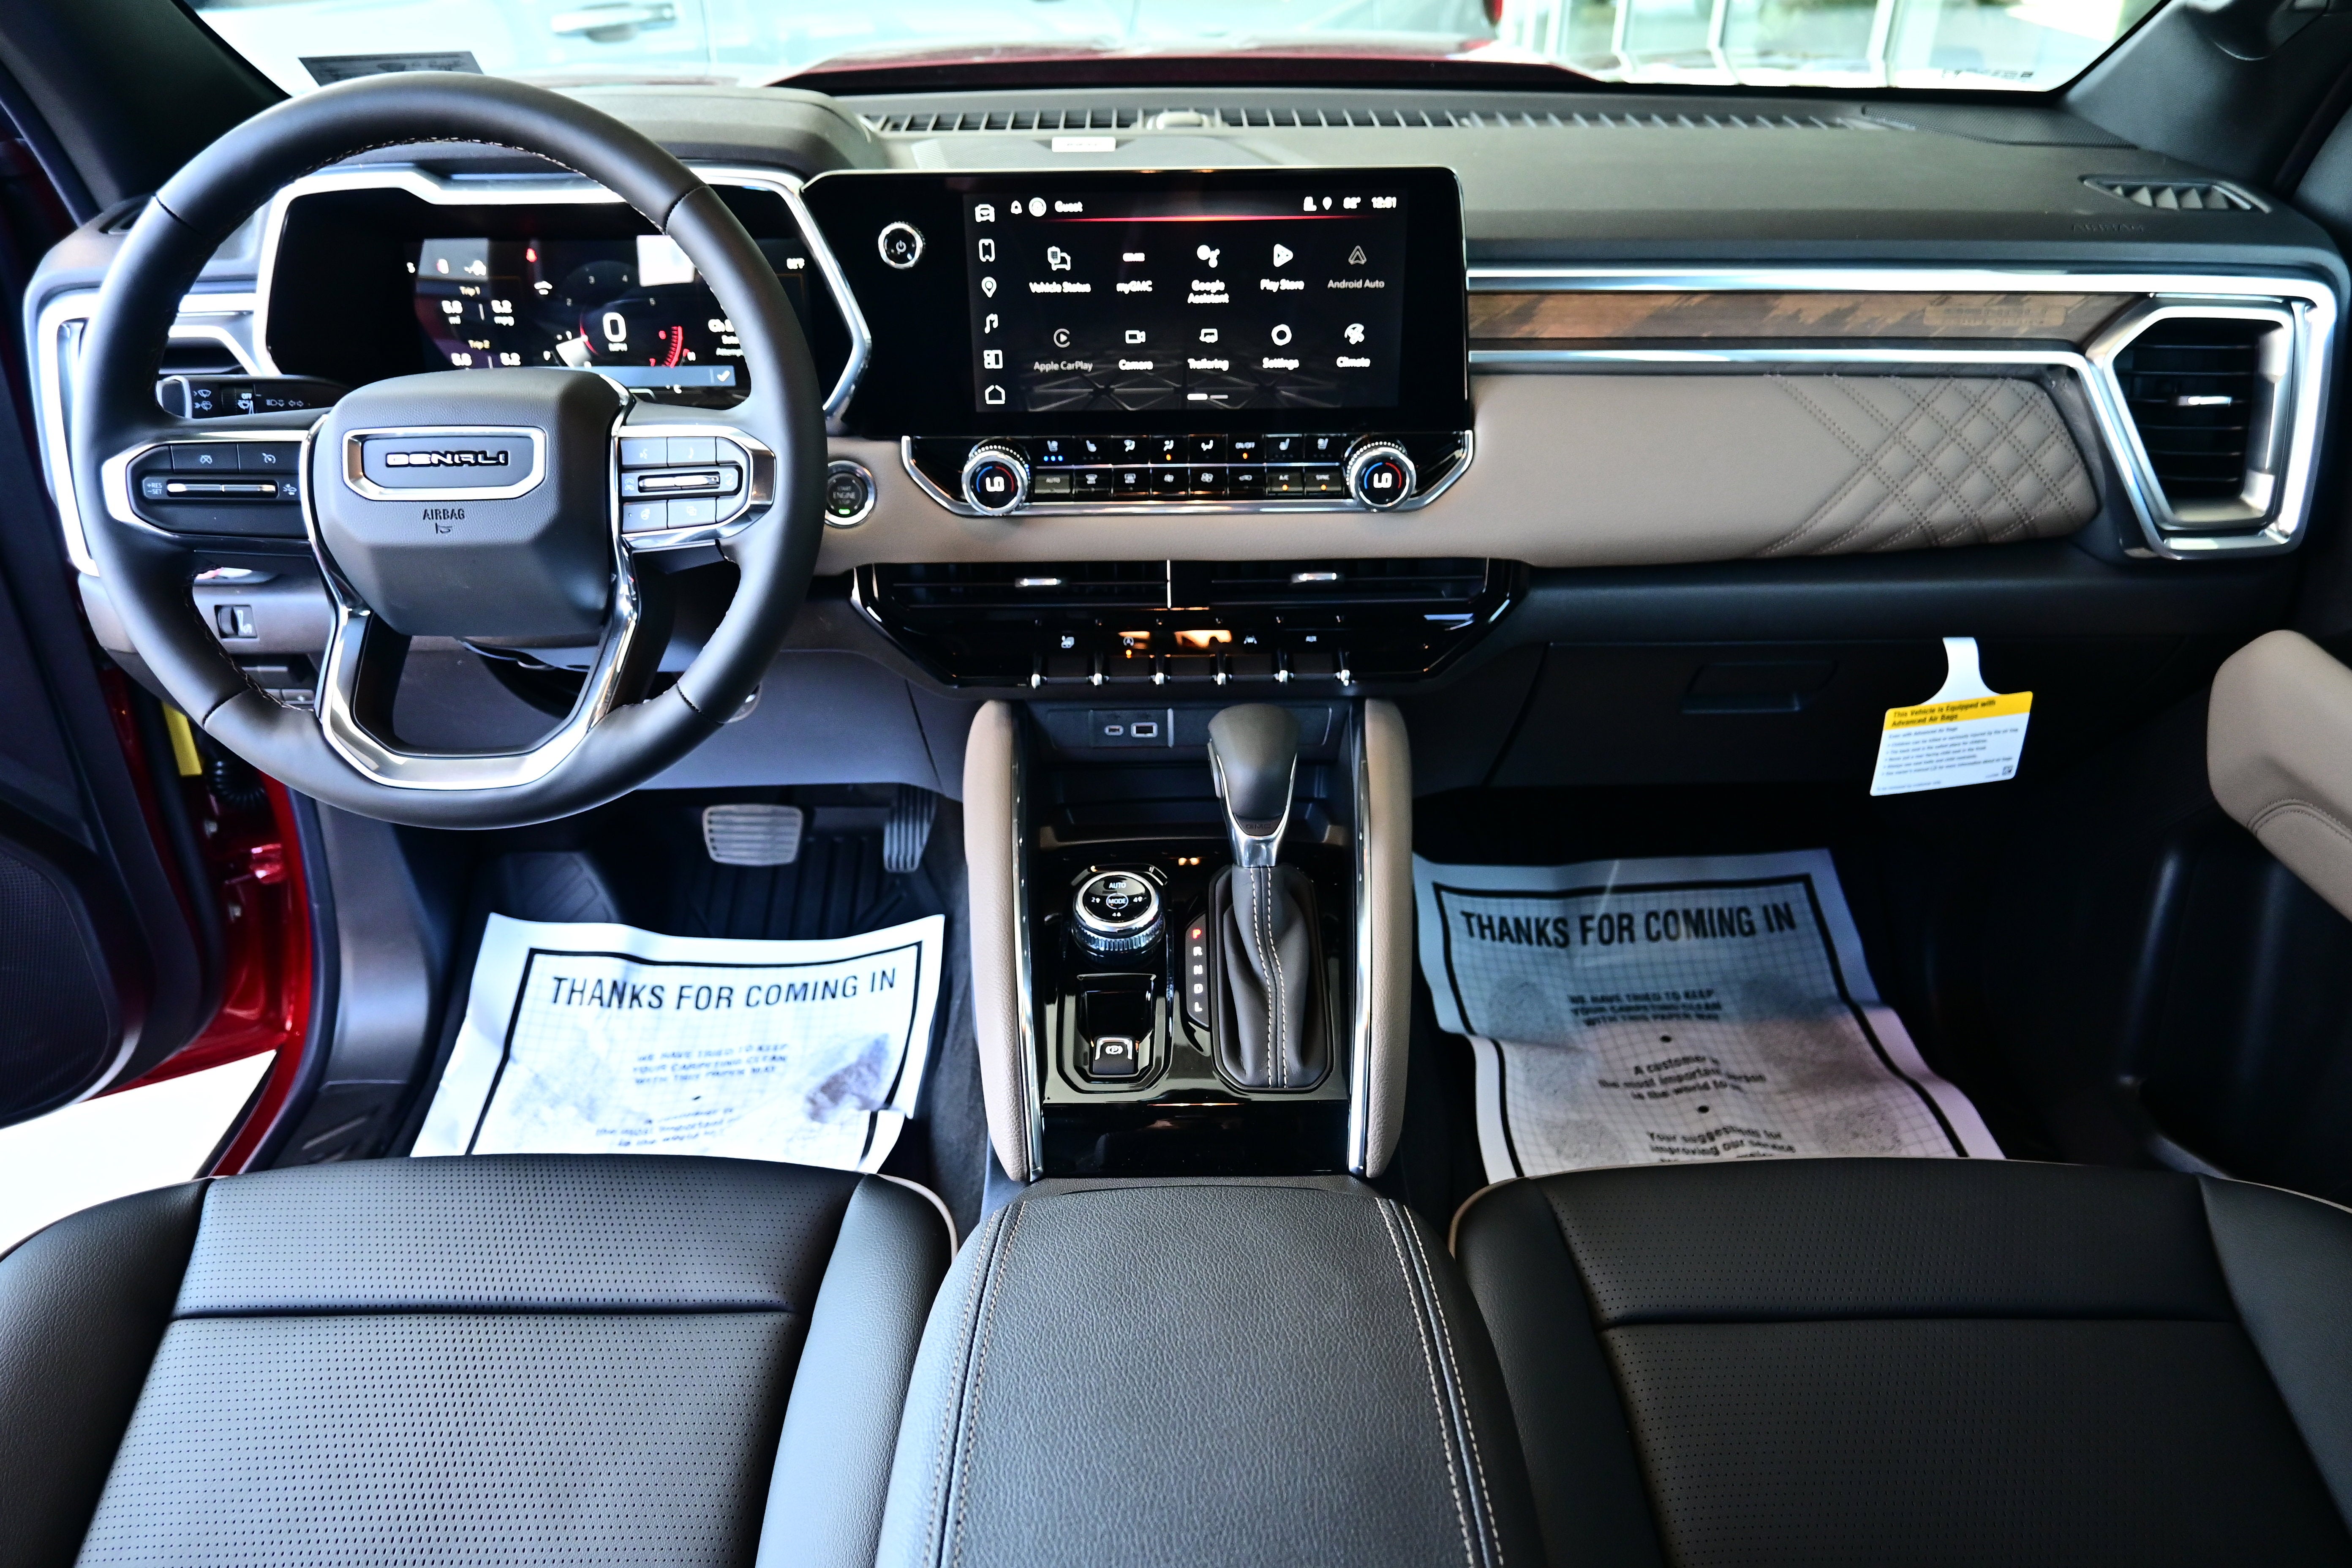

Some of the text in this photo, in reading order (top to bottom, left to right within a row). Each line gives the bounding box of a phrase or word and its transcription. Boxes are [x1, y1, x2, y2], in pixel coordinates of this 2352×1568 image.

[1116, 280, 1152, 294] myGMC
[1192, 280, 1225, 293] Google
[1260, 279, 1304, 292] Play Store
[1327, 279, 1385, 289] Android Auto
[603, 312, 626, 342] 0
[1034, 361, 1093, 373] Apple CarPlay
[1119, 359, 1153, 370] Camera
[1263, 357, 1299, 370] Settings
[1337, 357, 1370, 368] Climate
[386, 451, 508, 467] DENALI
[423, 509, 465, 520] AIRBAG
[1460, 901, 1797, 949] THANKS FOR COMING IN
[1193, 929, 1201, 939] P
[1193, 946, 1203, 956] R
[1194, 965, 1203, 975] N
[552, 968, 896, 1010] THANKS FOR COMING IN
[1194, 983, 1203, 994] D
[1195, 1002, 1203, 1012] L
[1634, 1065, 1644, 1075] A
[1647, 1056, 1706, 1073] customer
[1647, 1131, 1677, 1141] Your
[1681, 1125, 1761, 1144] suggestions
[1650, 1144, 1720, 1157] improving
[1722, 1139, 1745, 1152] our
